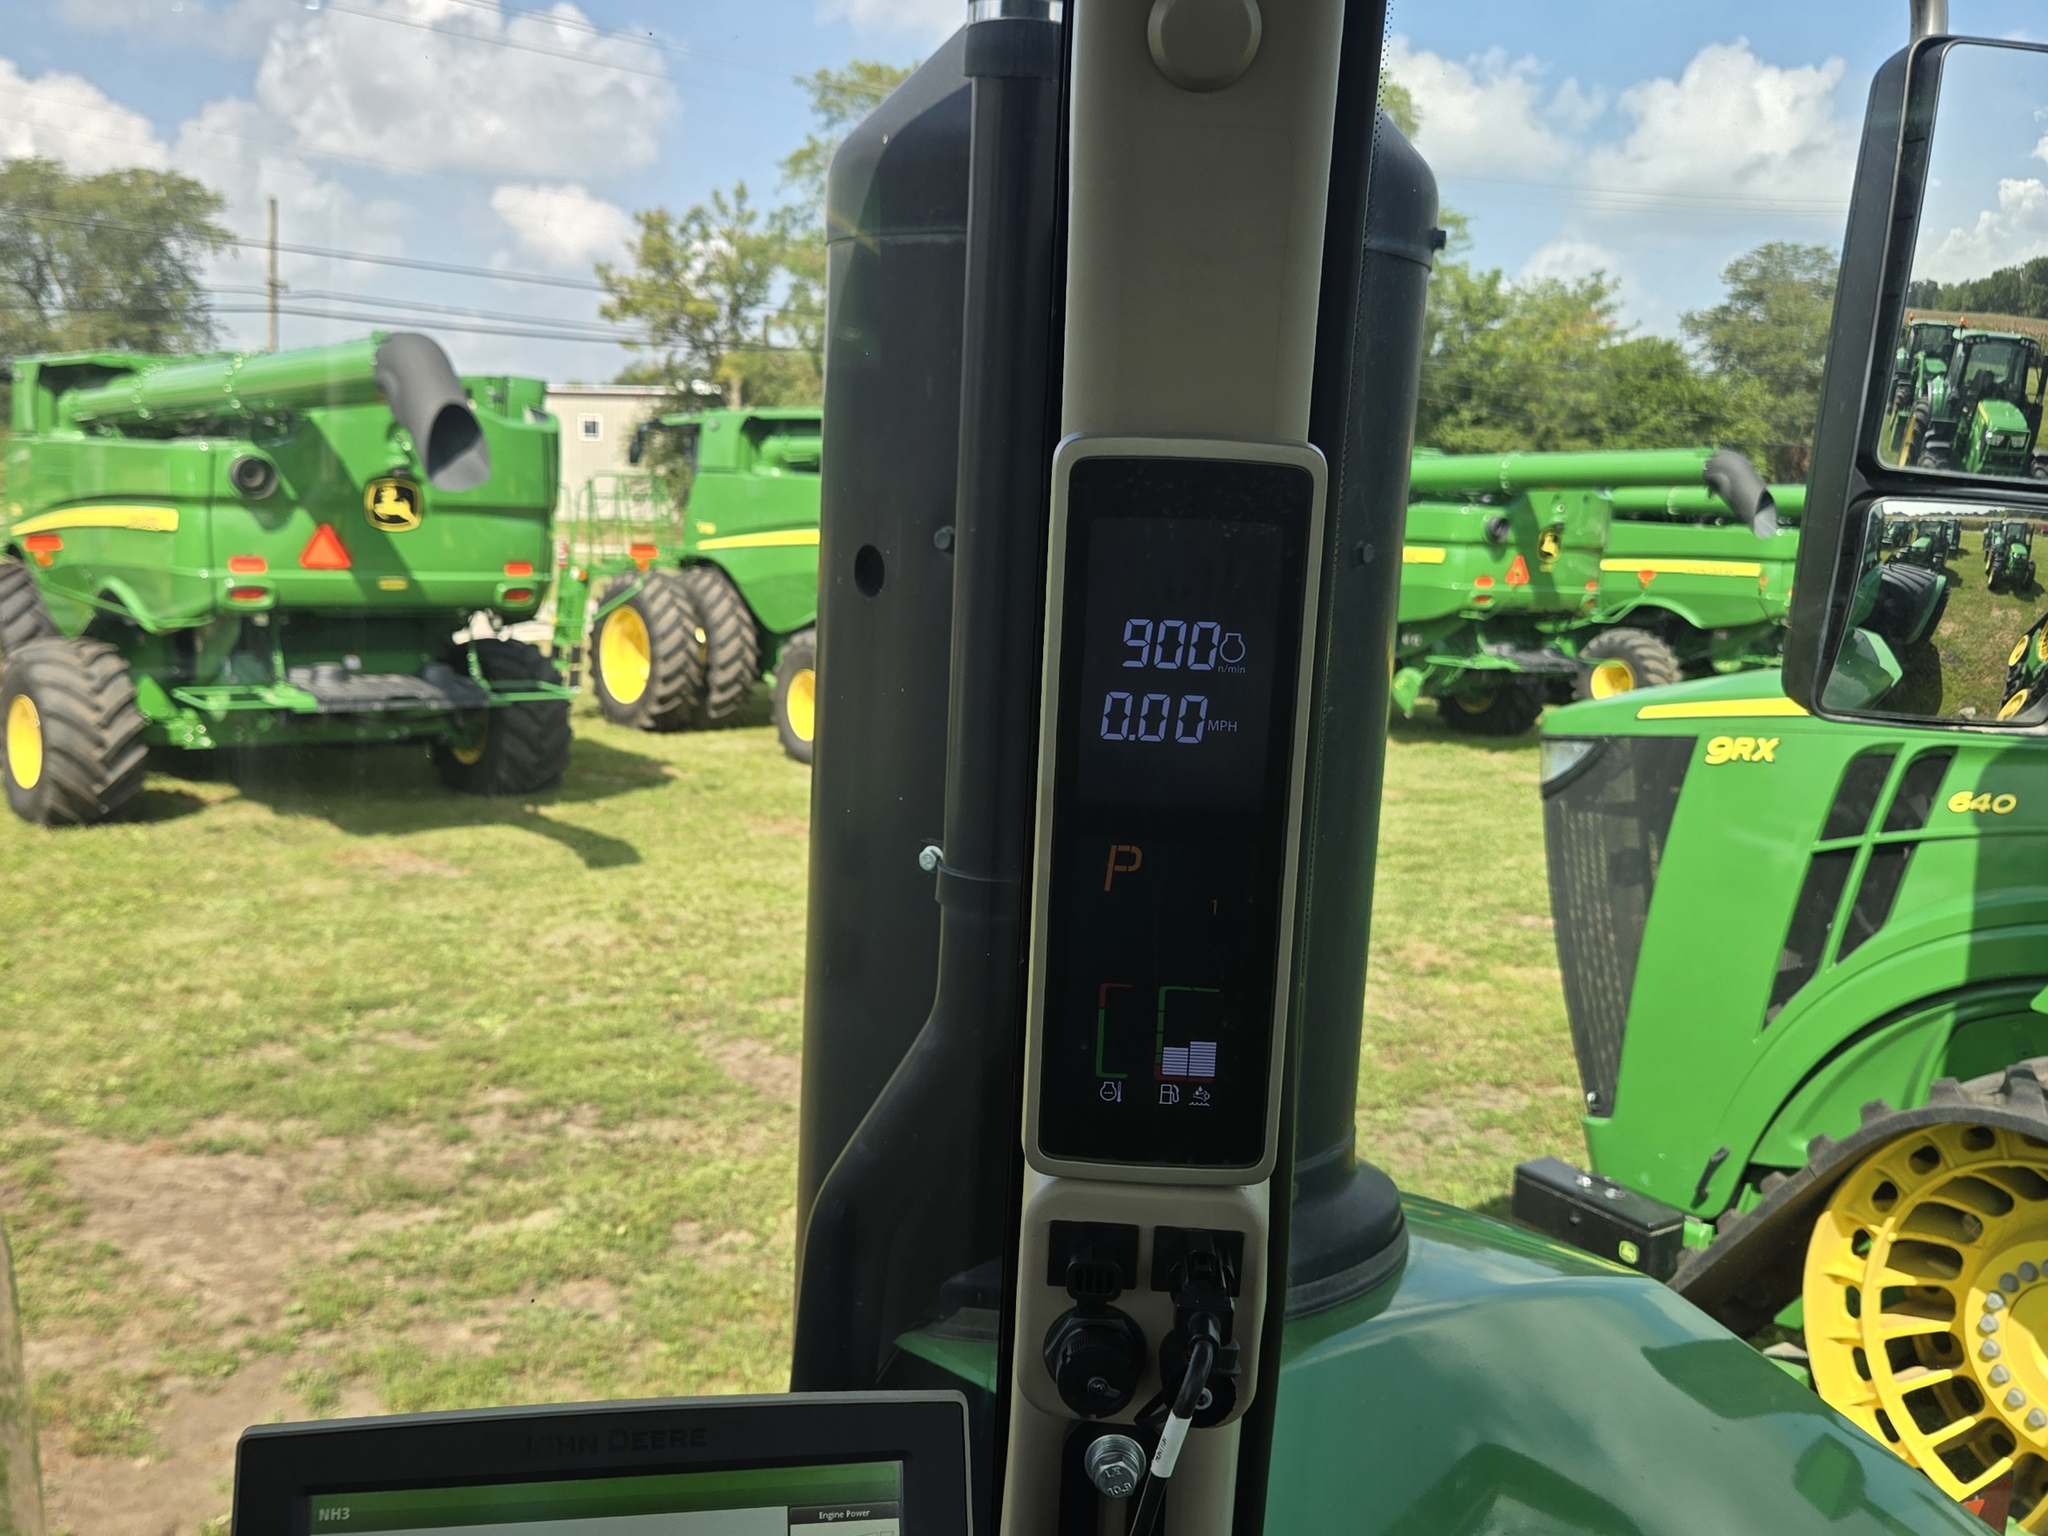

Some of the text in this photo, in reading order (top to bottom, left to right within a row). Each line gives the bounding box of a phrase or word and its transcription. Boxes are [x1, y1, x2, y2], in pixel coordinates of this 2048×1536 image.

[1122, 618, 1221, 671] 900
[1217, 664, 1246, 674] n/min
[1100, 691, 1238, 744] 0.00 MPH
[1704, 736, 1780, 765] 9RX
[1947, 791, 2018, 815] 640
[1104, 844, 1143, 892] P
[525, 1427, 708, 1456] JOHN DEERE
[317, 1506, 350, 1522] NH3
[818, 1509, 871, 1521] Engine Power
